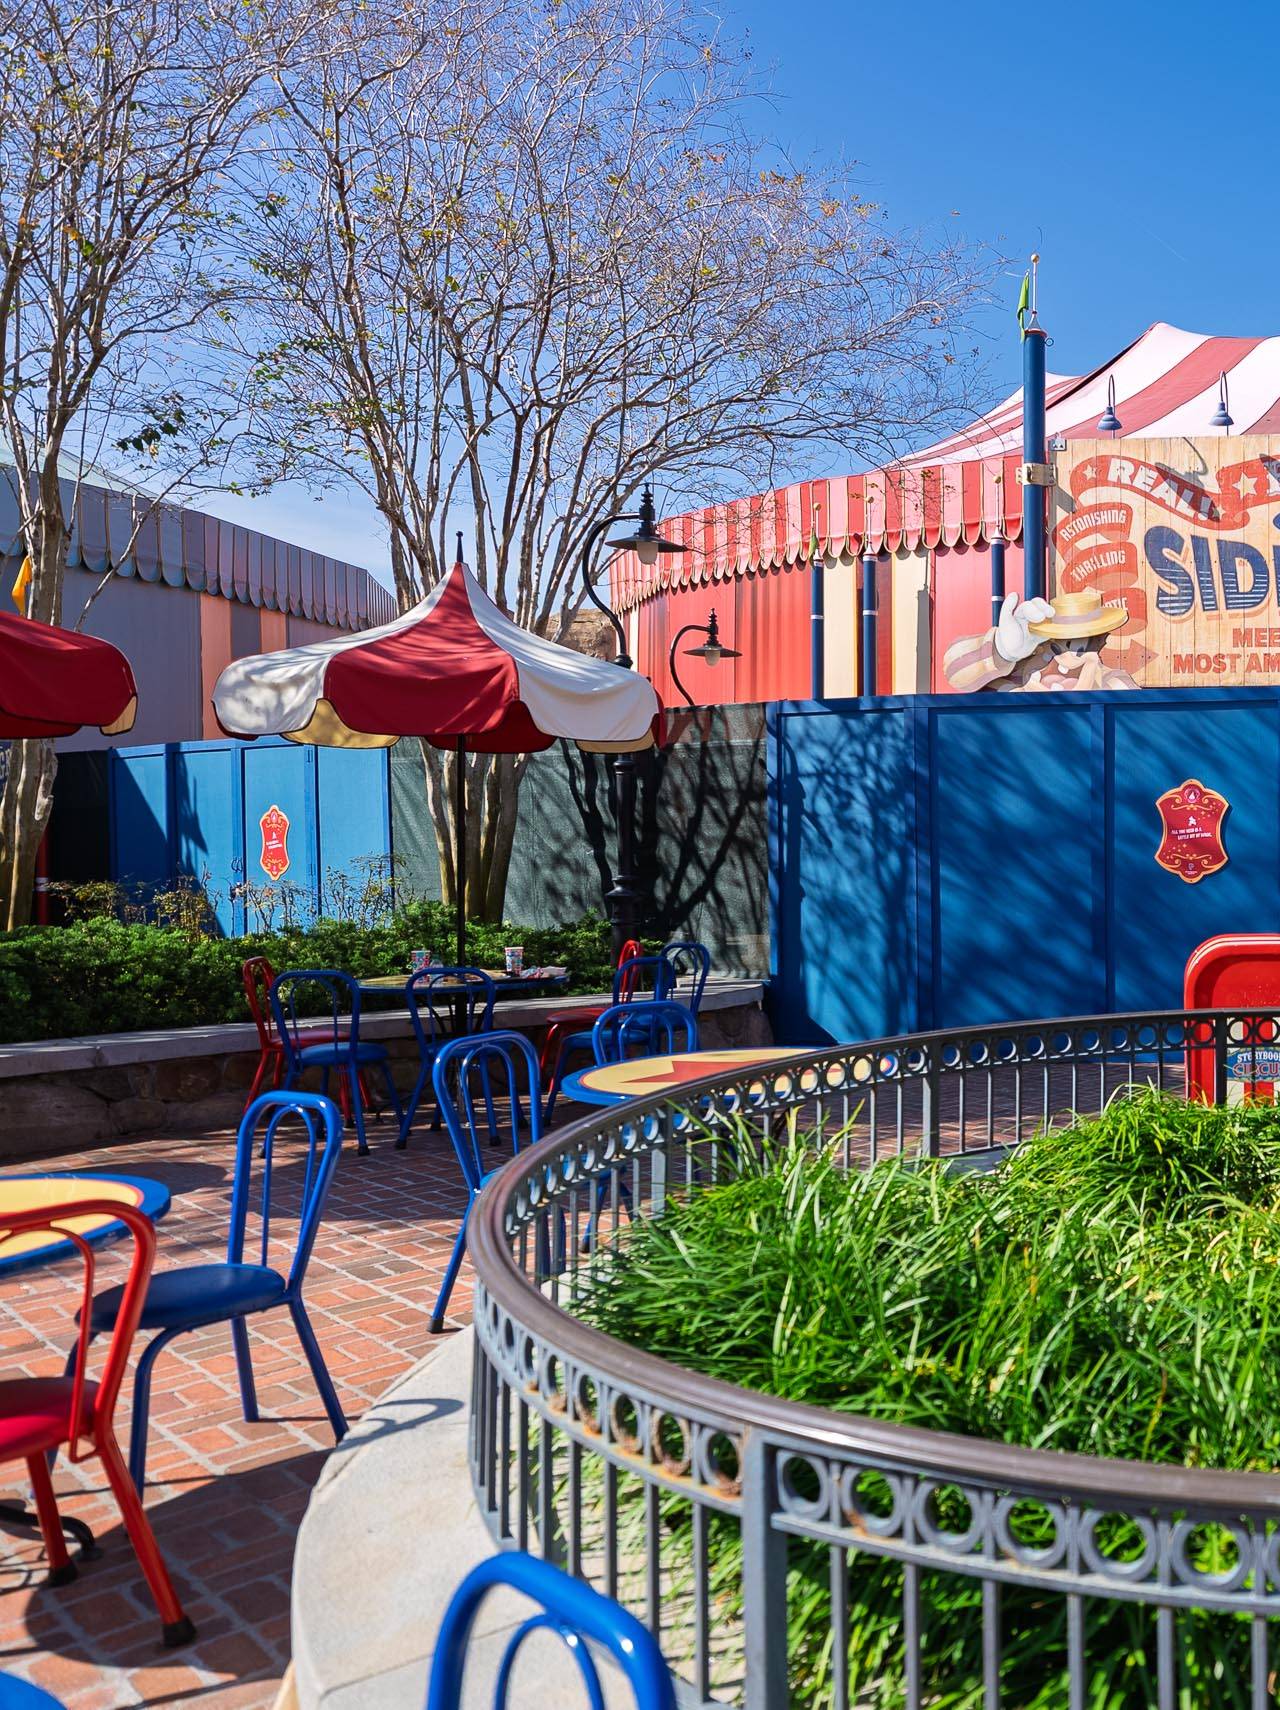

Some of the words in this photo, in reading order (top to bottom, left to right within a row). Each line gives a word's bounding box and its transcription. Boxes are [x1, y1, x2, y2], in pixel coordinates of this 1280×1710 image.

[1107, 458, 1215, 521] REAL!
[1059, 509, 1127, 542] ASTONISHING
[1070, 551, 1126, 582] THRILLING
[1173, 653, 1241, 674] MOST
